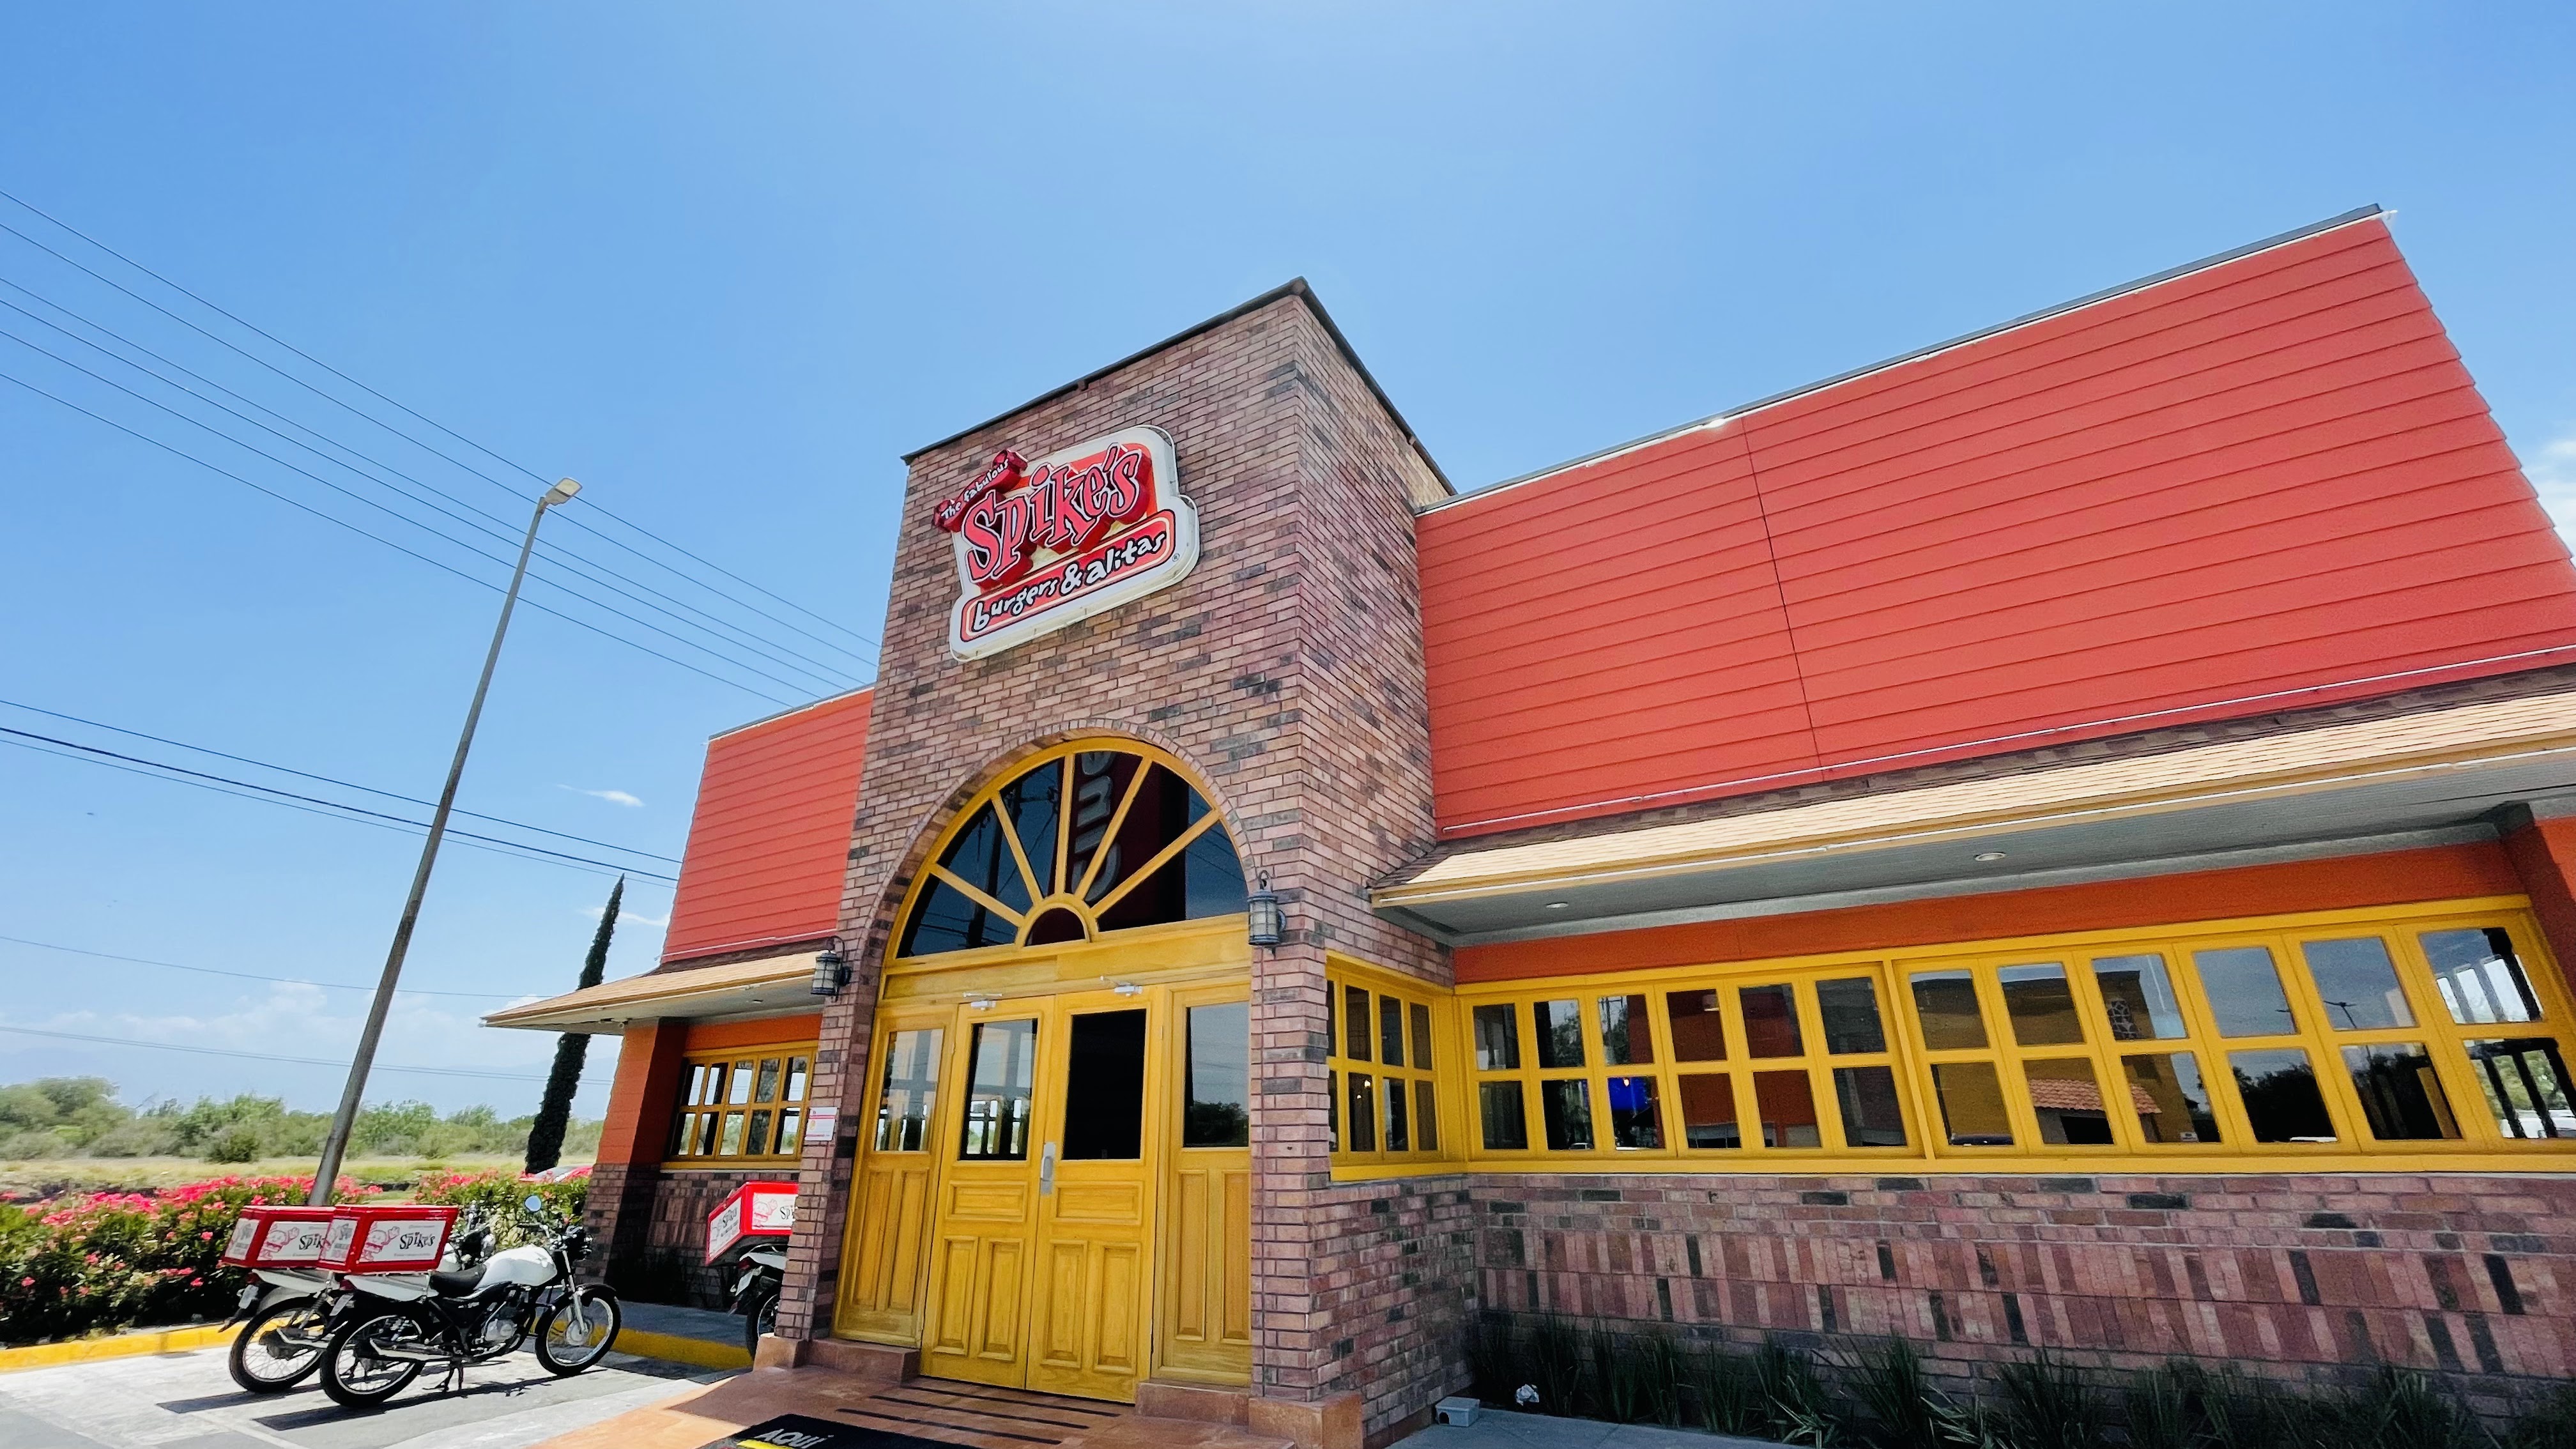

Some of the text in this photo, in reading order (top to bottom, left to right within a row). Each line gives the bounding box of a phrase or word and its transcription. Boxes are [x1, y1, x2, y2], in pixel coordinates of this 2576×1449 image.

[940, 458, 1009, 519] The fabulous
[960, 442, 1143, 584] Spike's
[973, 533, 1166, 632] burgers & alitas
[399, 1231, 436, 1250] Spike's
